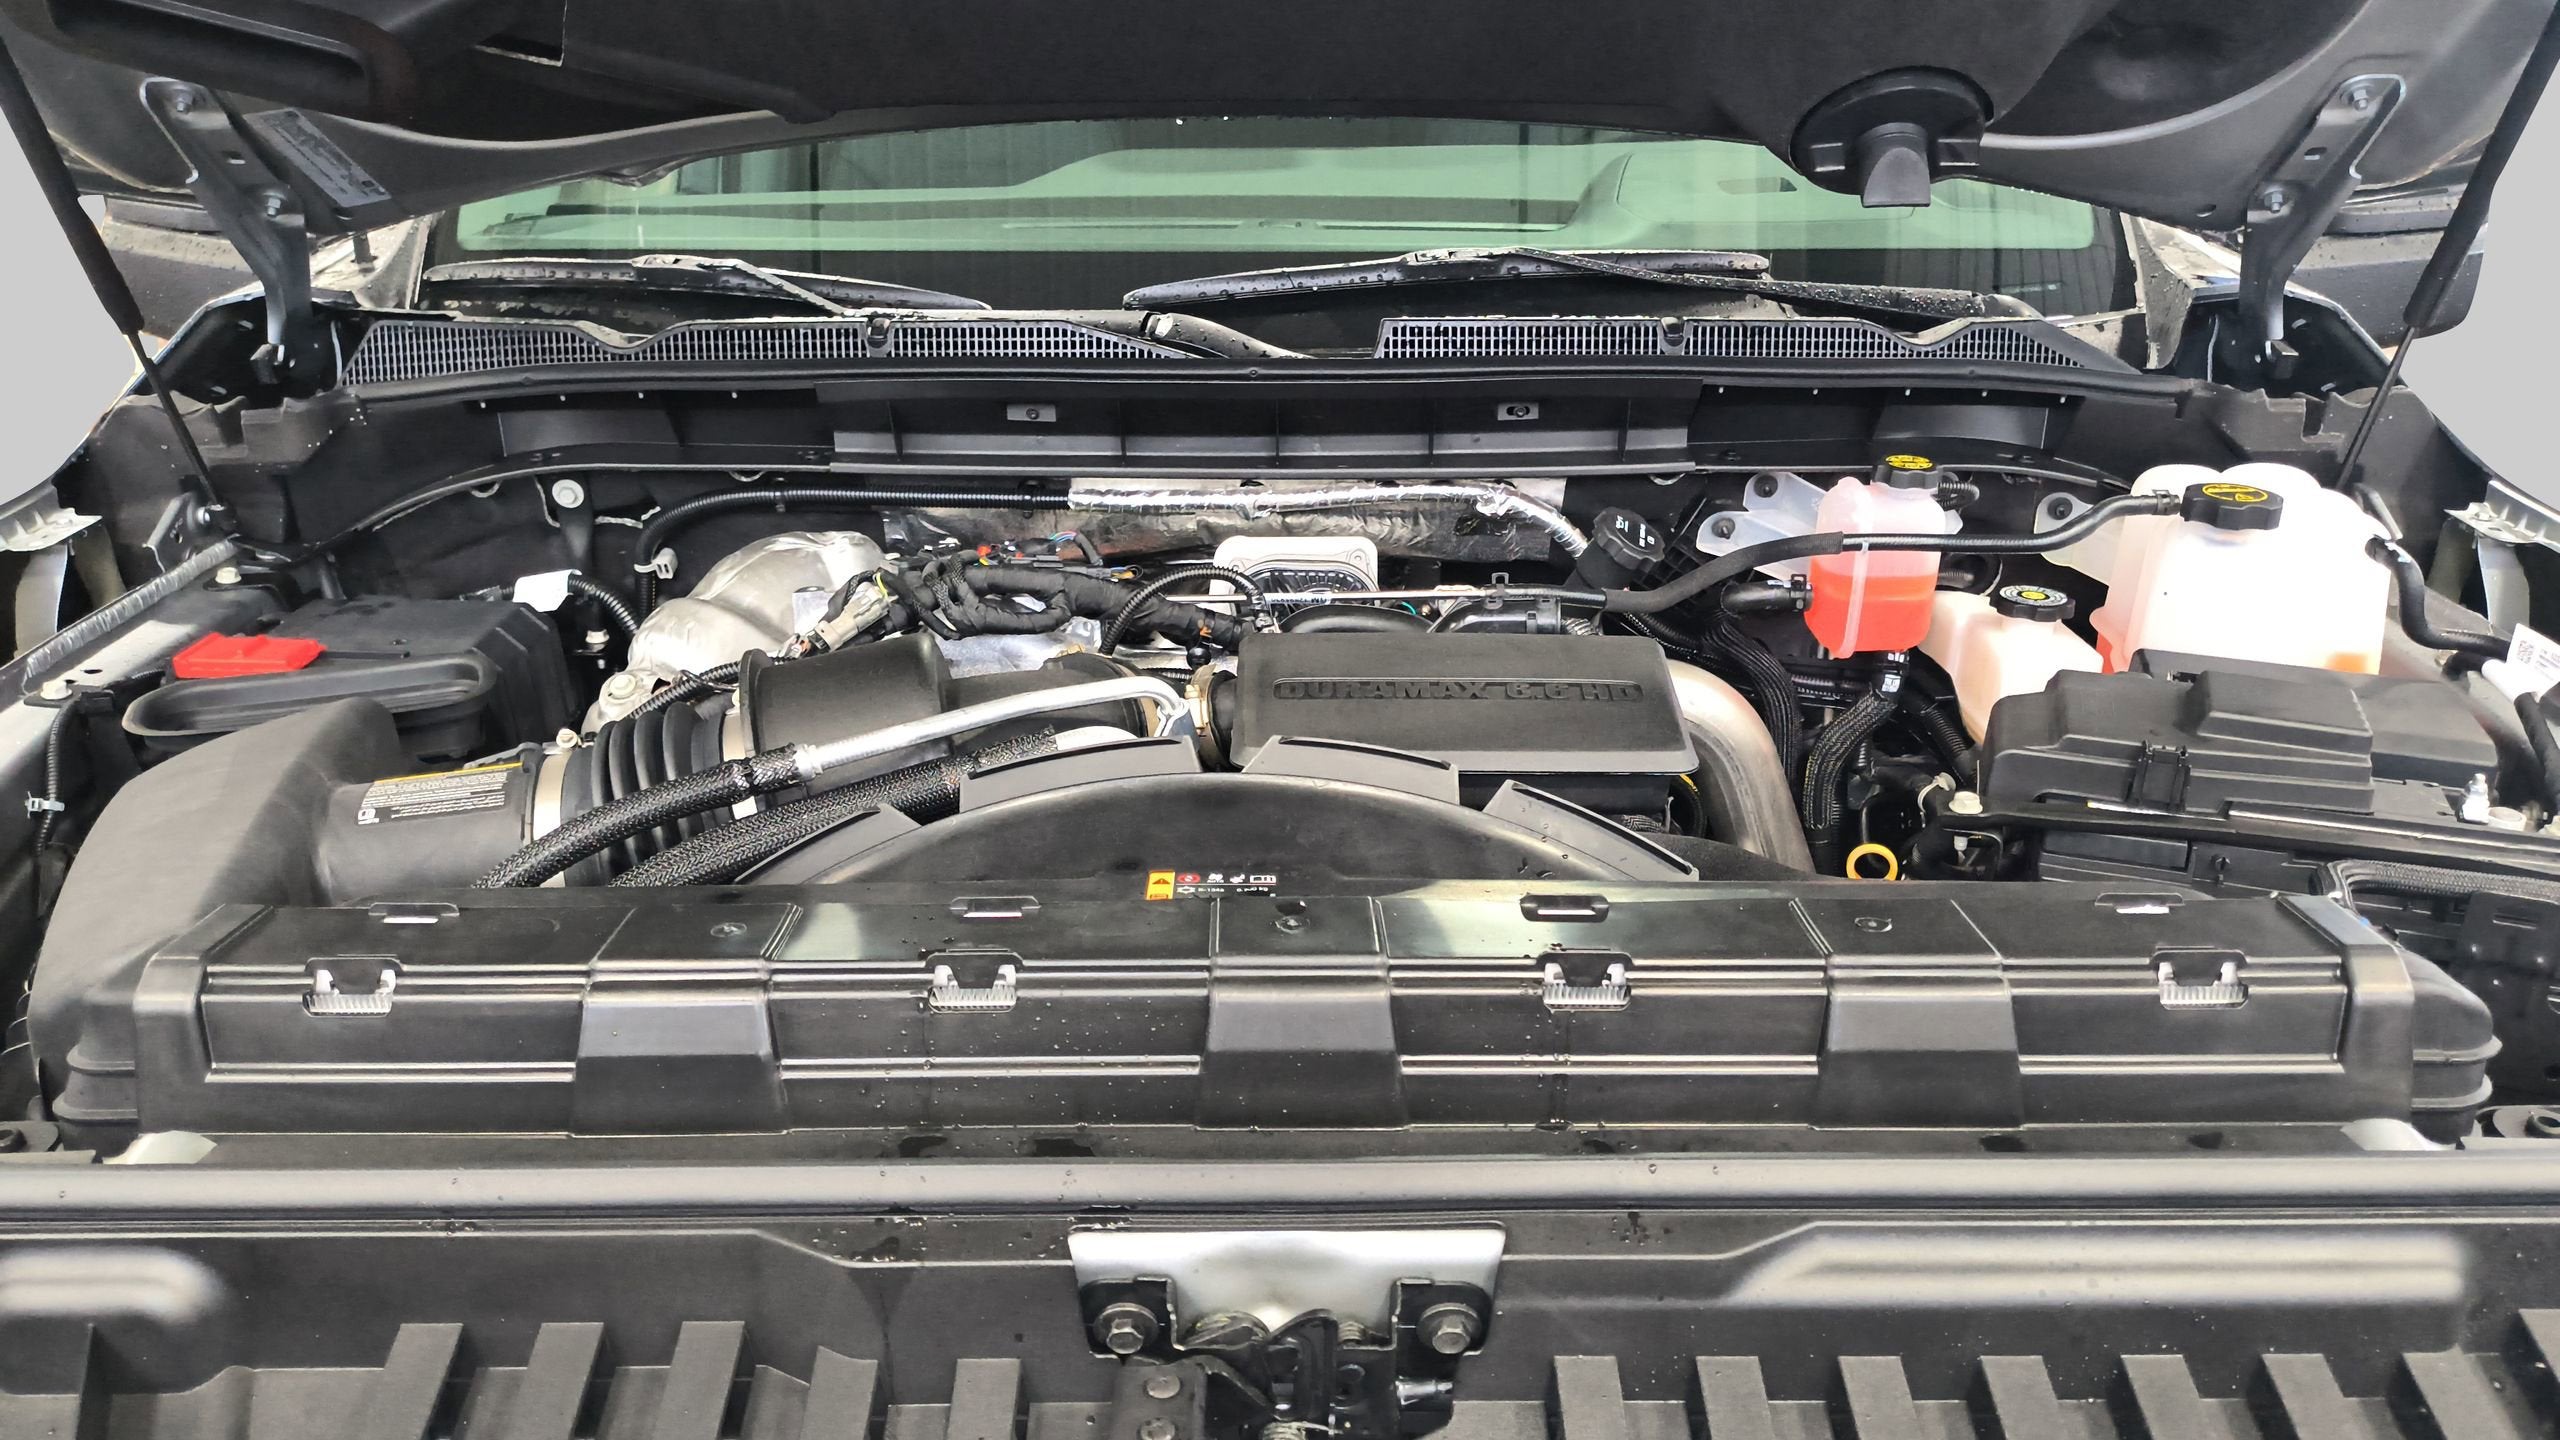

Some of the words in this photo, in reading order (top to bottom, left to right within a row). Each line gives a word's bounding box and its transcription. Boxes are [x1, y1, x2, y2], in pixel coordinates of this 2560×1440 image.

[1277, 679, 1489, 700] DURAMAX
[1504, 680, 1569, 700] 6.6
[1580, 682, 1637, 701] HD
